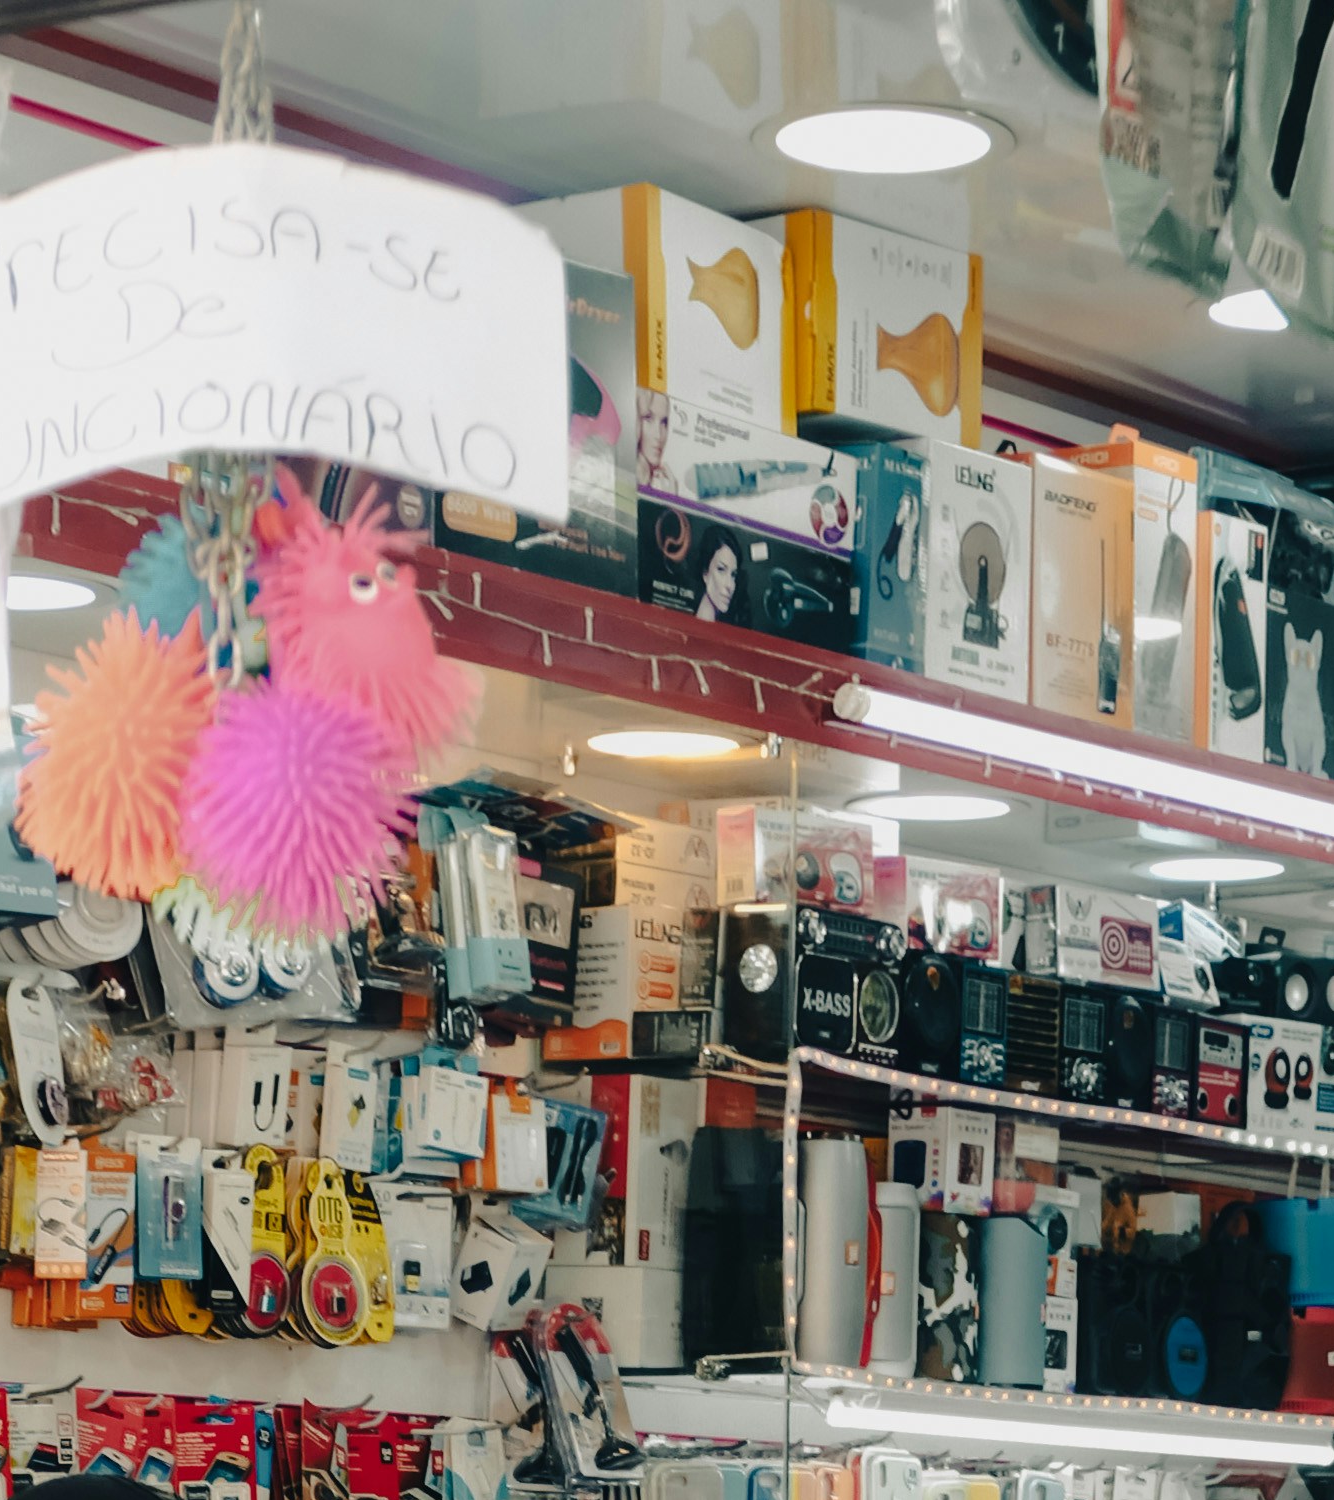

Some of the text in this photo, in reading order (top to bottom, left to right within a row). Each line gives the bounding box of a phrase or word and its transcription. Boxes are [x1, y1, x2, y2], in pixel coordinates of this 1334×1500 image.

[1044, 487, 1098, 514] BAOFENG
[802, 986, 851, 1019] X-BASS
[317, 1195, 343, 1224] OTG
